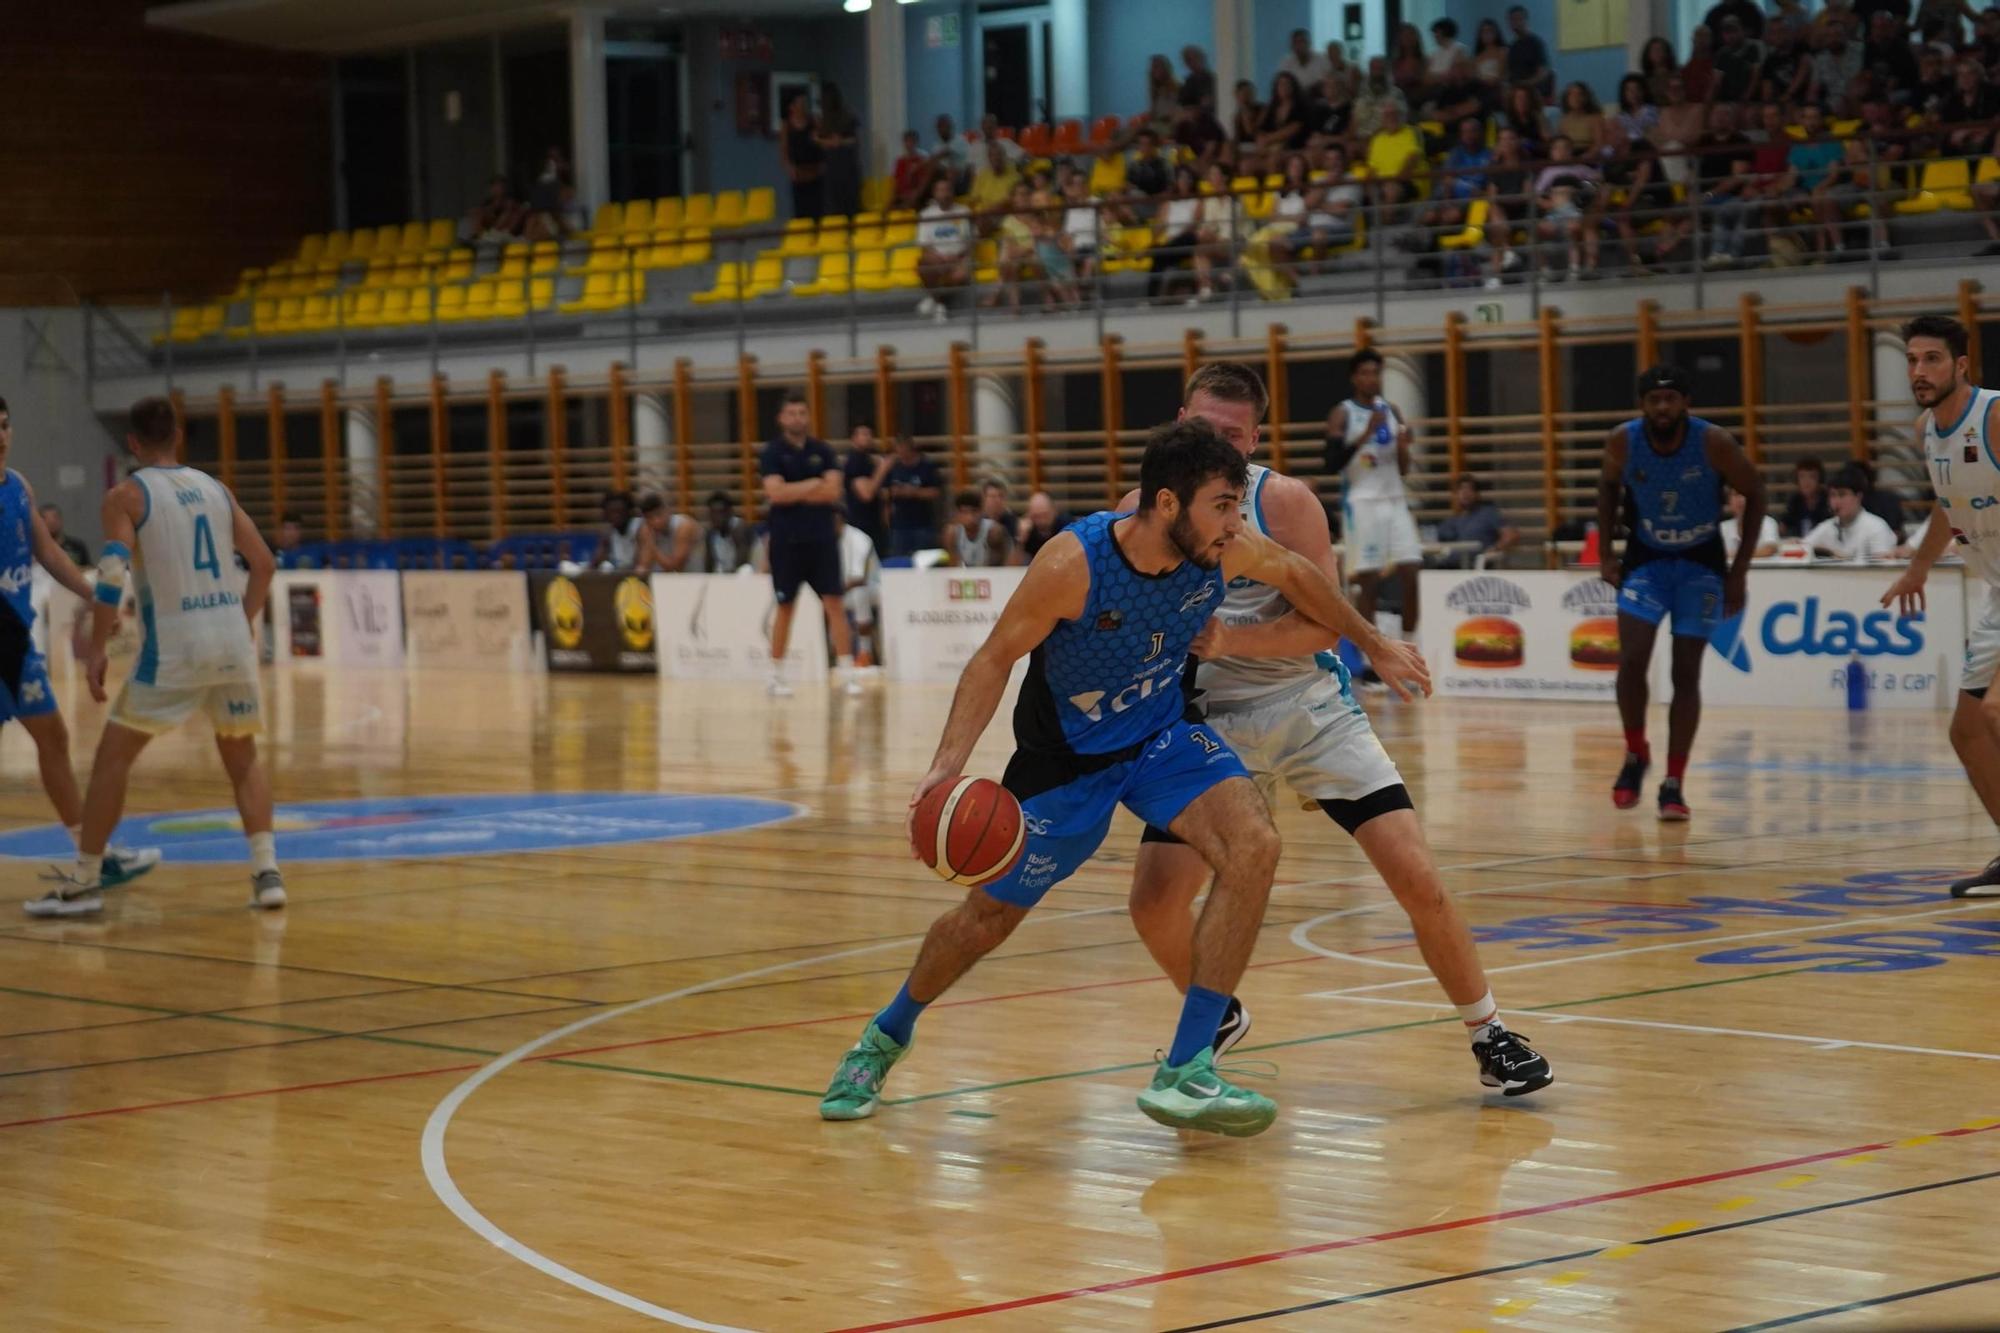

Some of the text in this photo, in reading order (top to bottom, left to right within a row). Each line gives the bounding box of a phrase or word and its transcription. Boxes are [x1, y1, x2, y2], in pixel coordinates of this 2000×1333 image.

[194, 513, 221, 580] 4
[1884, 674, 1897, 691] a
[1903, 672, 1937, 691] car
[1190, 731, 1220, 754] 1
